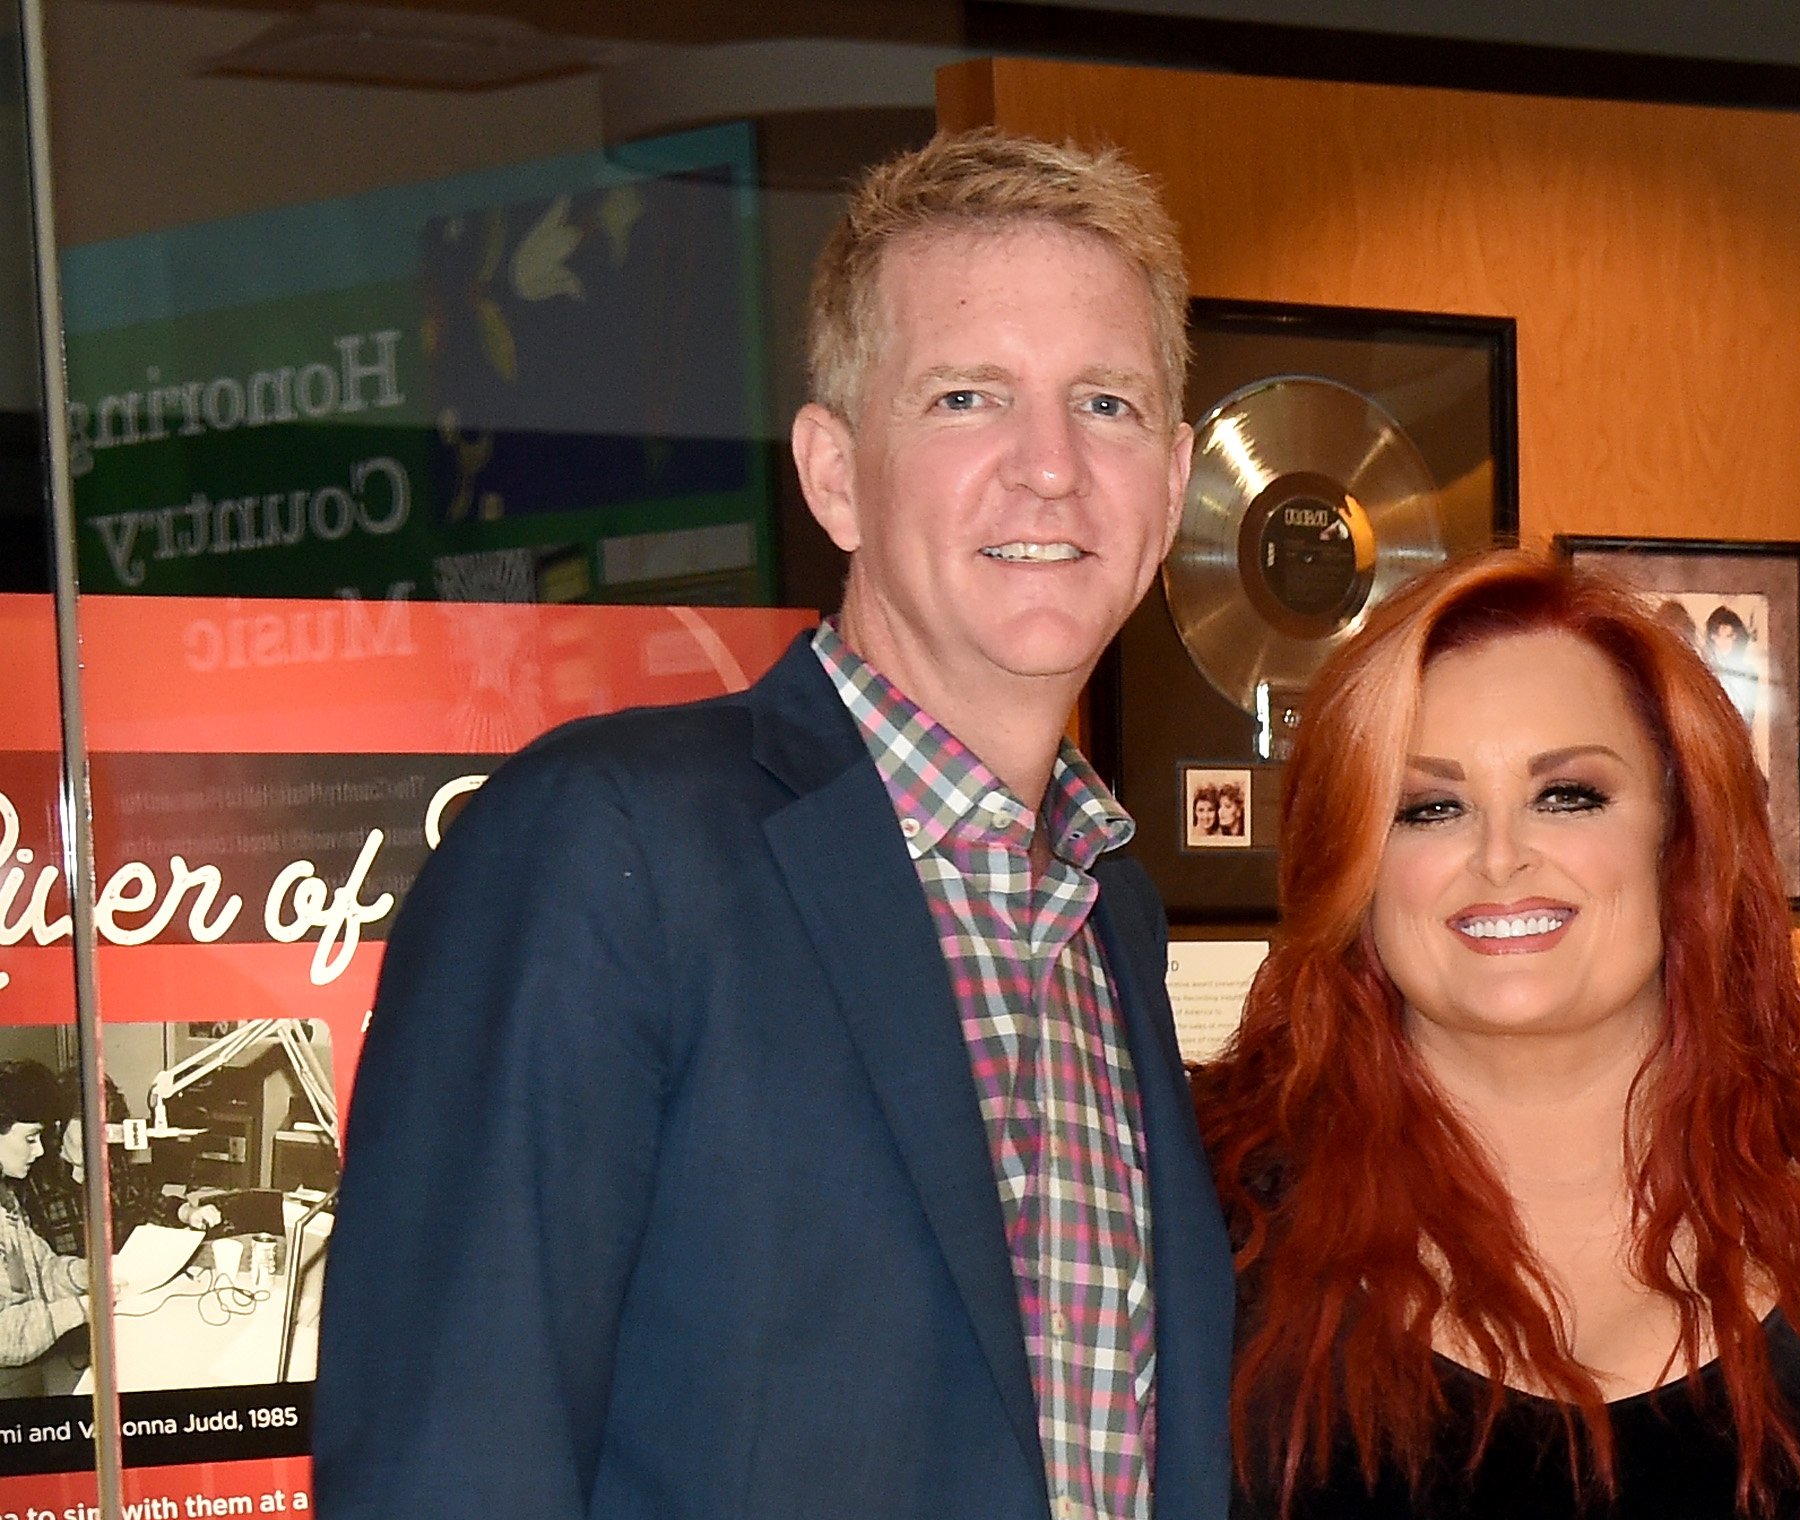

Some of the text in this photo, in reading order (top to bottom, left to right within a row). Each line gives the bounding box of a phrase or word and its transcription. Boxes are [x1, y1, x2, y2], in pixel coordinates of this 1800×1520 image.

[265, 828, 394, 986] of
[29, 1421, 71, 1442] and
[183, 1411, 244, 1434] Judd,
[249, 1406, 299, 1429] 1985
[185, 1494, 253, 1518] them
[260, 1490, 286, 1512] at
[292, 1491, 309, 1510] a
